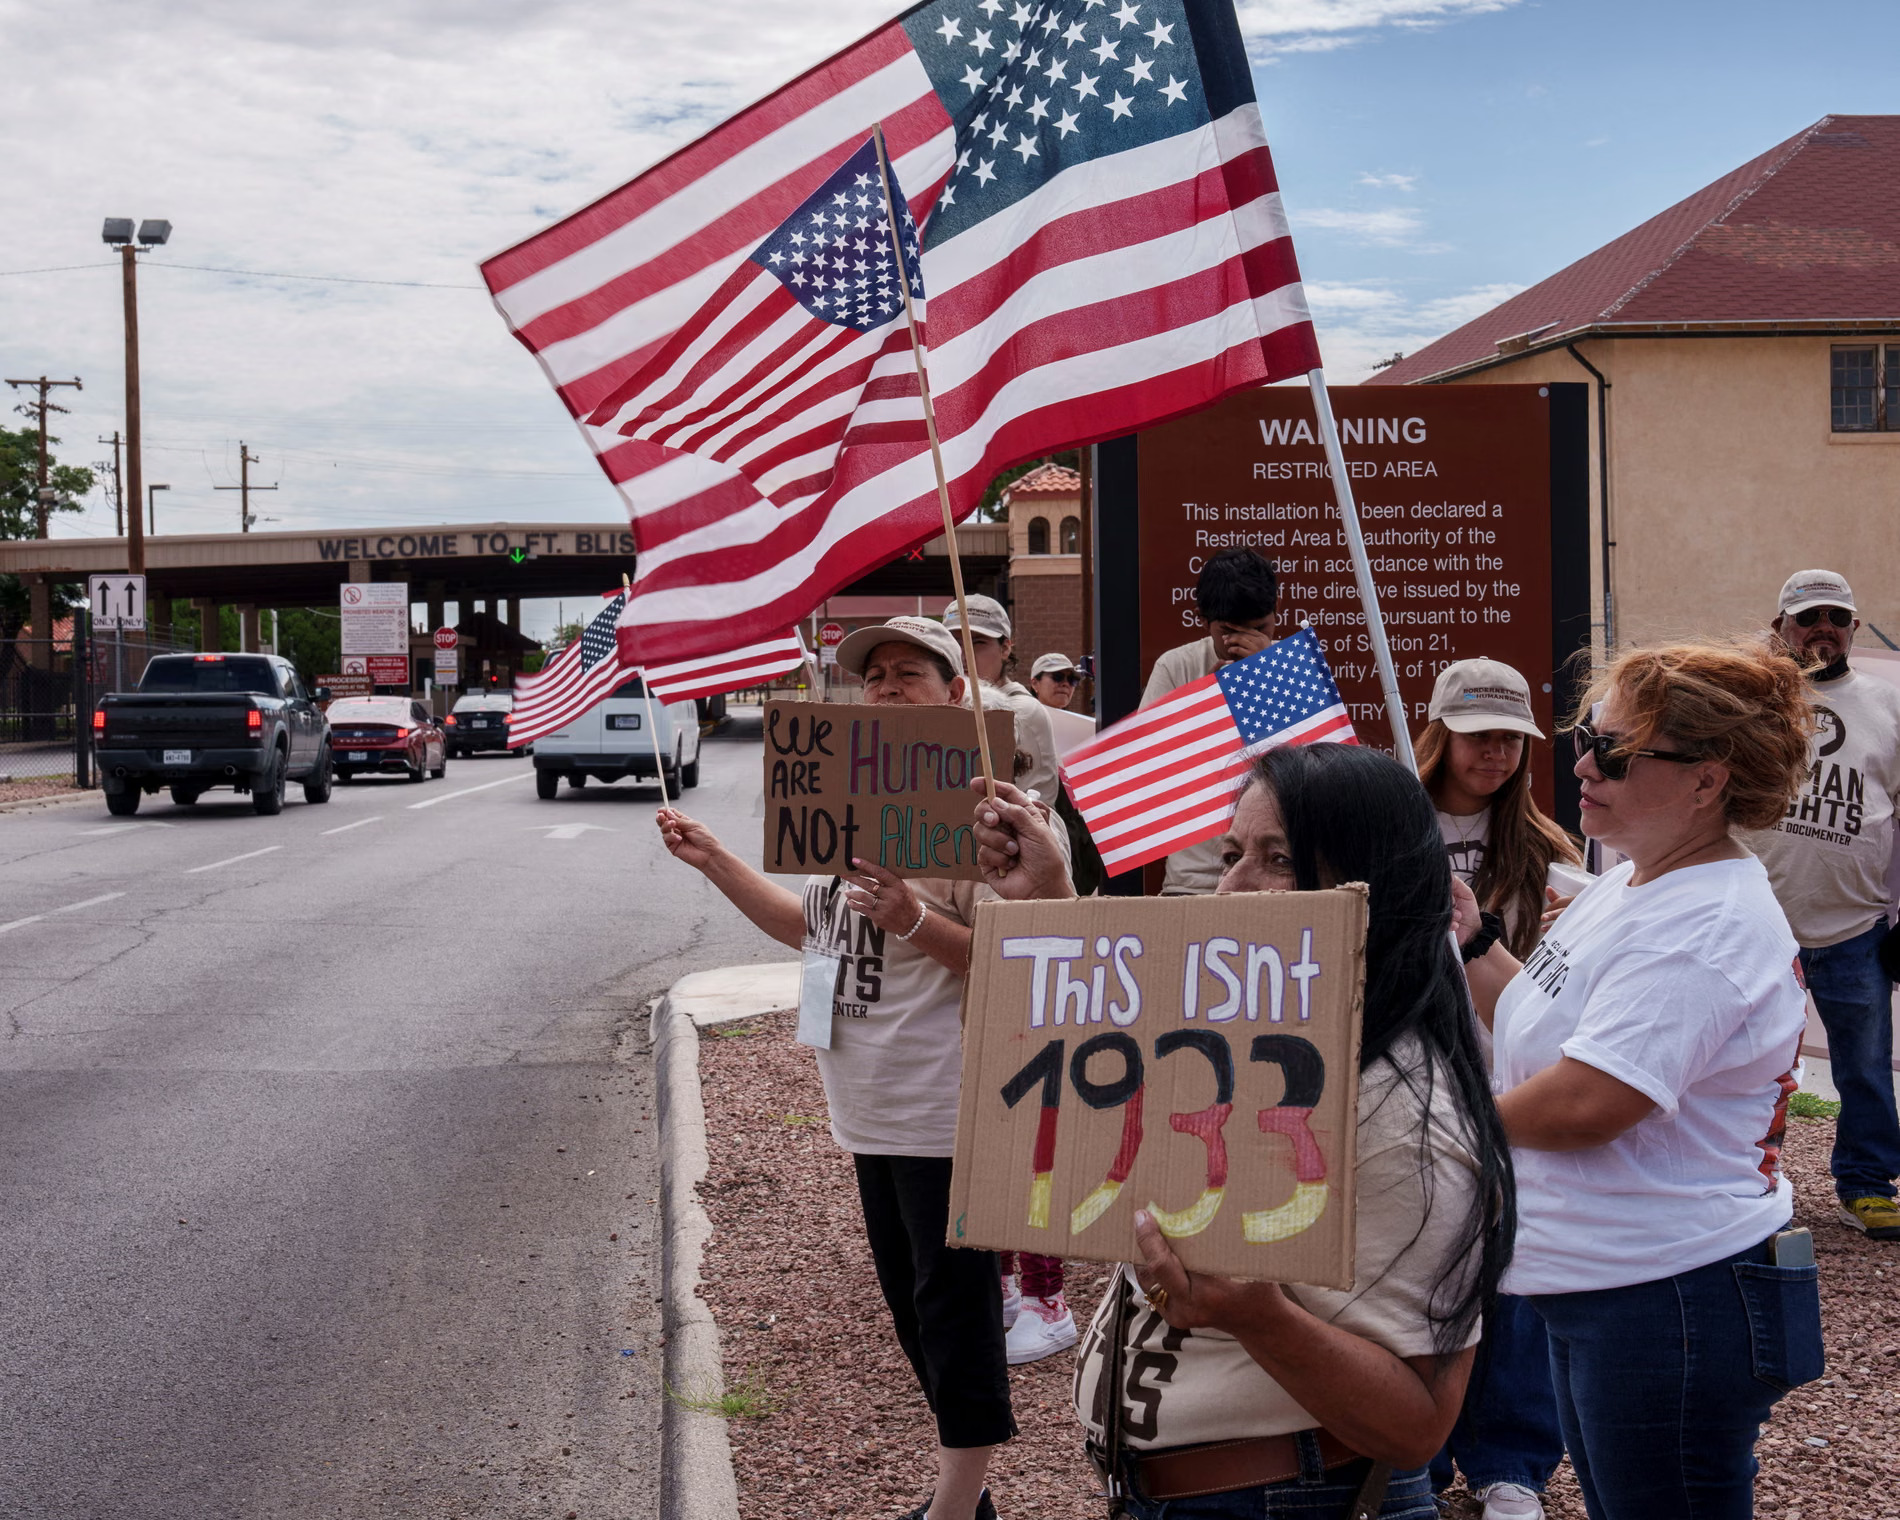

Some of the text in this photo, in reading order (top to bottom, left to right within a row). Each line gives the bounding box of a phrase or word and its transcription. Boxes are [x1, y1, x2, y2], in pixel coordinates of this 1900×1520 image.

[1383, 461, 1438, 478] AREA
[1182, 500, 1503, 520] This installation ha been declared a
[317, 532, 635, 561] WELCOME TO FT. BLIS
[1196, 527, 1496, 549] Restricted Area b authority of the
[1304, 556, 1319, 573] in
[1324, 555, 1428, 573] accrdance
[1433, 554, 1470, 571] with
[1475, 554, 1503, 571] the
[1277, 580, 1521, 601] f the direcive issued by the
[93, 618, 116, 626] ONLY
[1295, 608, 1367, 626] Defense
[1460, 608, 1477, 624] to
[1483, 607, 1511, 623] the
[436, 633, 456, 643] STOP
[822, 630, 842, 640] STOP
[1334, 634, 1352, 652] of
[1357, 633, 1423, 652] Stion
[1429, 633, 1456, 653] 21,
[317, 676, 370, 684] IN-PROCESSING
[1332, 660, 1457, 682] urity At of 19
[768, 709, 834, 756] We
[771, 760, 823, 799] ARE
[1806, 759, 1865, 805] MAN
[1785, 823, 1852, 847] DOCUMENTER
[803, 884, 886, 957] UMAN
[1002, 933, 1144, 1029] This
[1000, 1029, 1328, 1243] 1933
